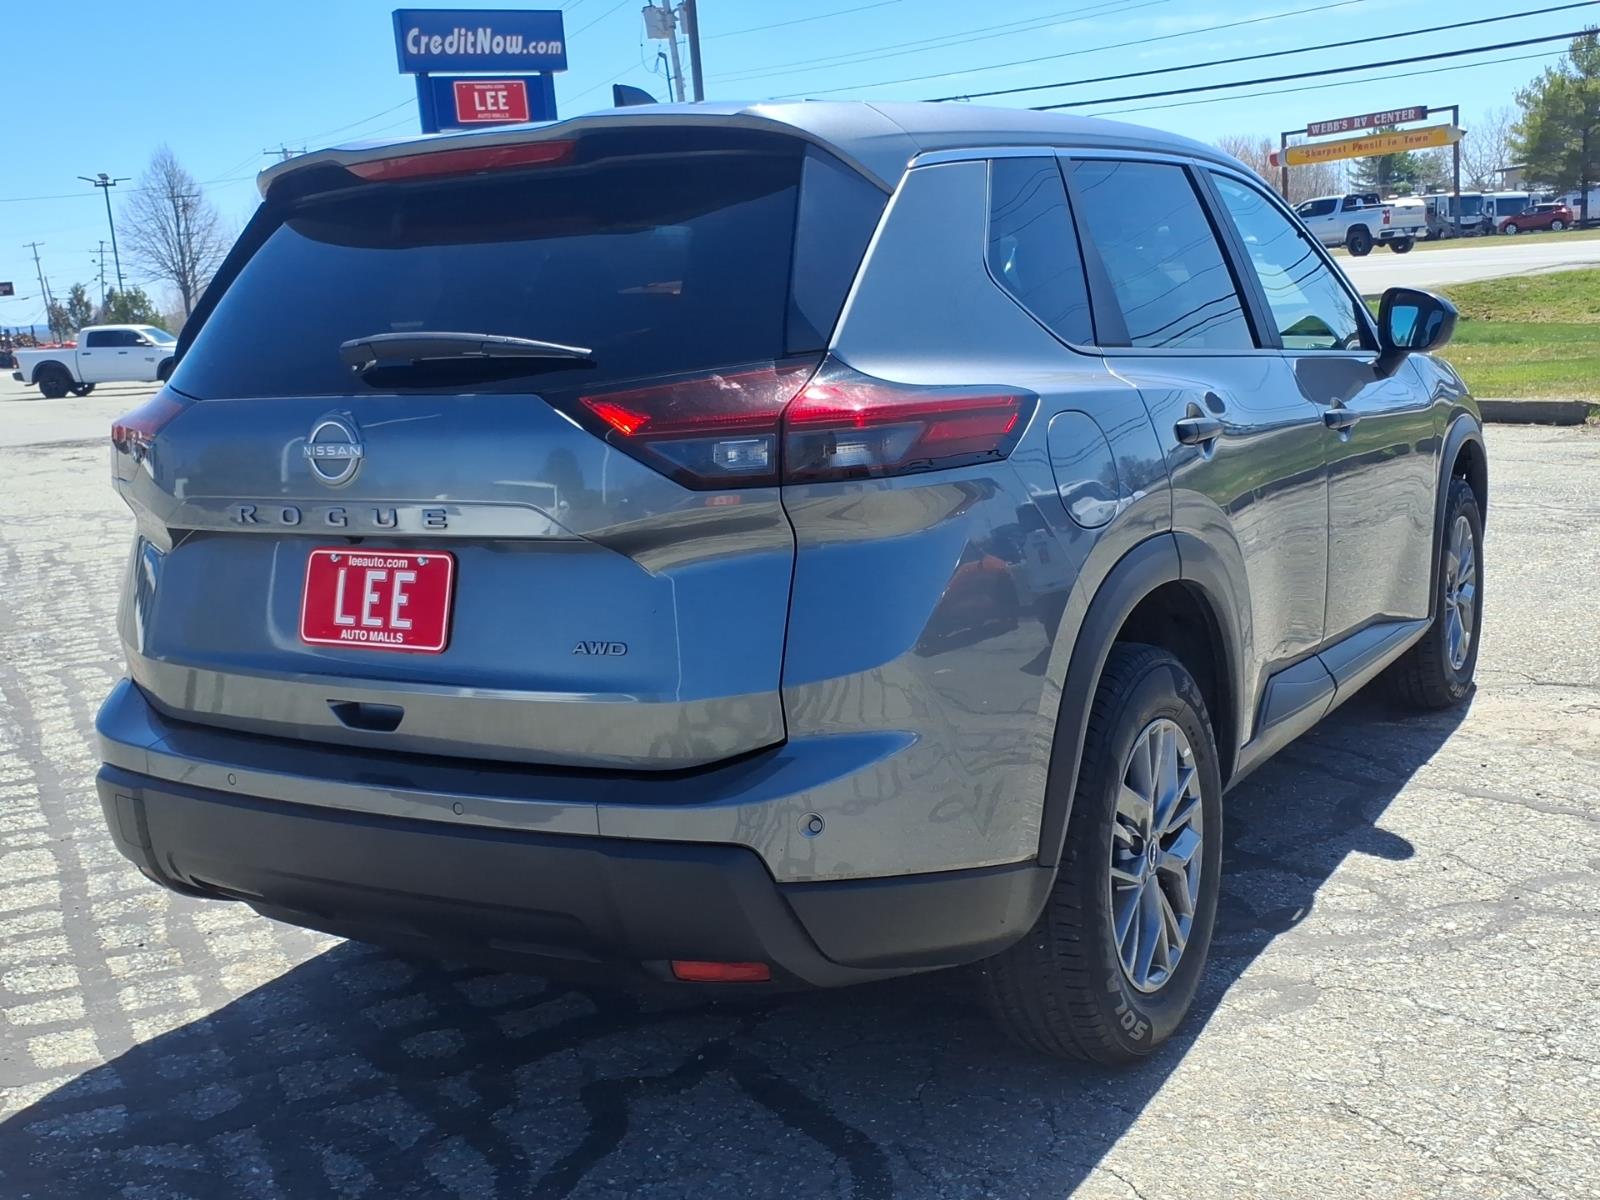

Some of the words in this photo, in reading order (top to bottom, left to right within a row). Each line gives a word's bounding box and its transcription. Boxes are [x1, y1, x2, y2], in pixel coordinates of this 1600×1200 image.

[406, 28, 562, 55] CreditNow.com
[474, 91, 510, 111] LEE
[1311, 118, 1349, 135] WEBB'S
[1353, 116, 1368, 128] RV
[1374, 108, 1416, 125] CENTER
[303, 446, 362, 456] NISSAN
[237, 505, 449, 530] ROGUE
[348, 554, 408, 569] leeauto.com
[333, 567, 417, 630] LEE
[340, 629, 368, 641] AUTO
[369, 630, 404, 644] MALLS
[571, 640, 628, 657] AWD
